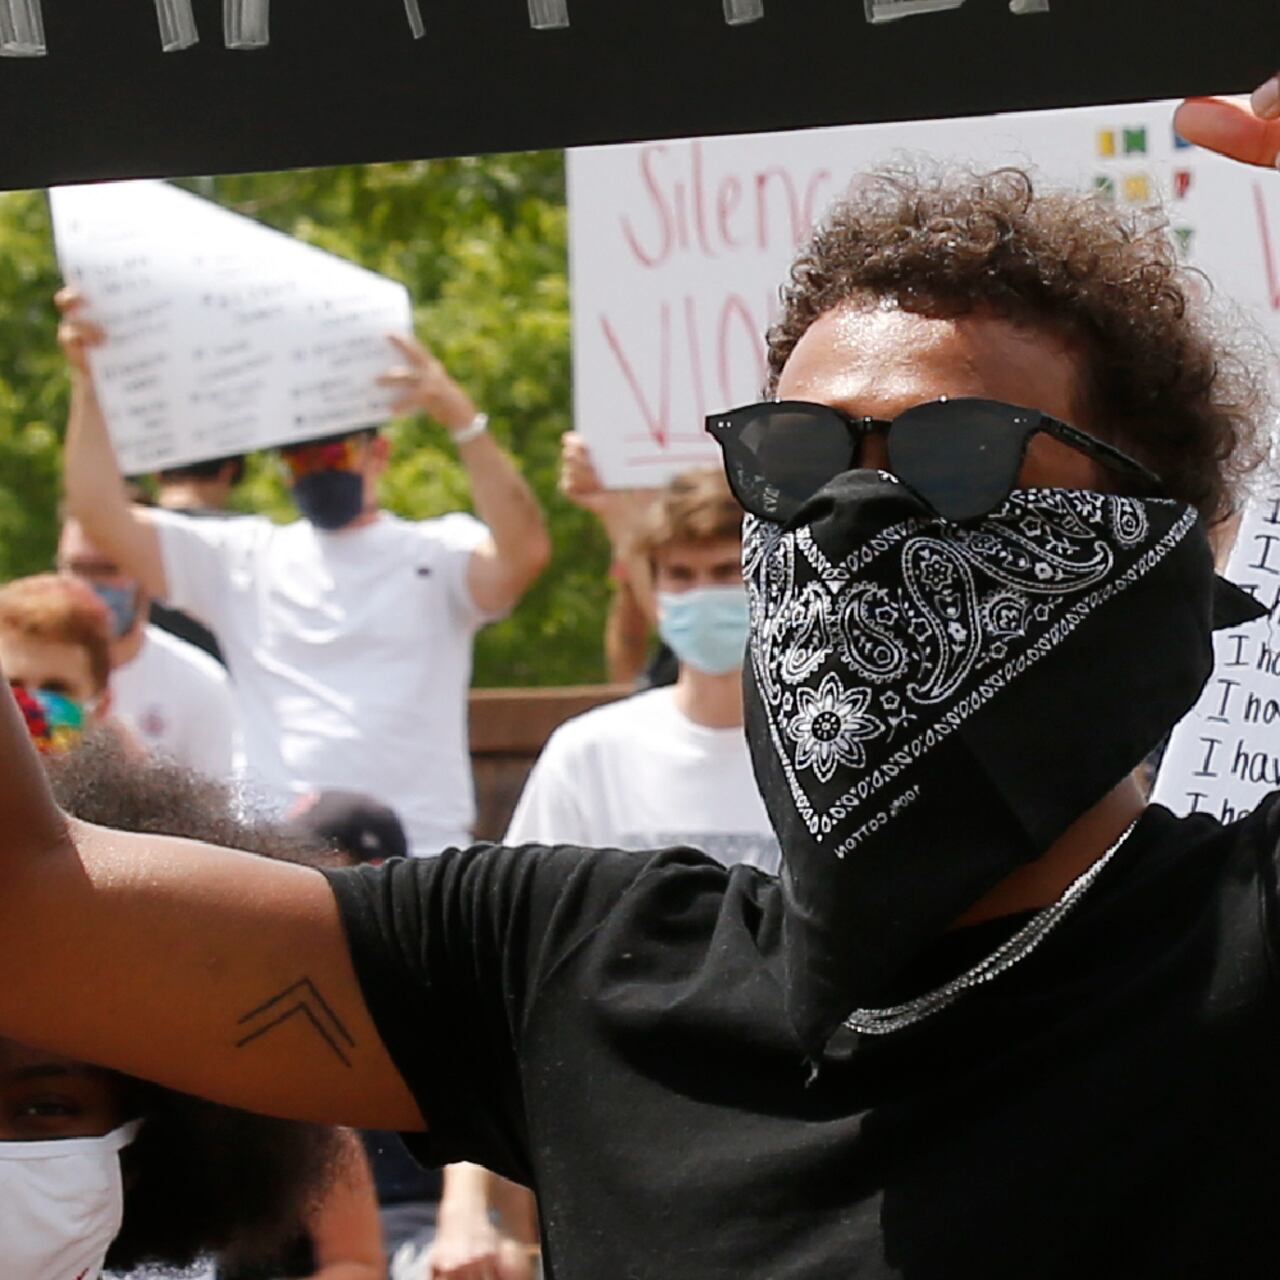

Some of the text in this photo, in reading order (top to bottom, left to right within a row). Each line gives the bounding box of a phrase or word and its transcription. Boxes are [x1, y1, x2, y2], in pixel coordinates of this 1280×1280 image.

[622, 138, 833, 269] Silenc
[598, 292, 778, 450] VIO
[1248, 534, 1280, 575] I
[1223, 634, 1250, 666] I
[1207, 678, 1241, 725] I
[1192, 737, 1222, 777] I
